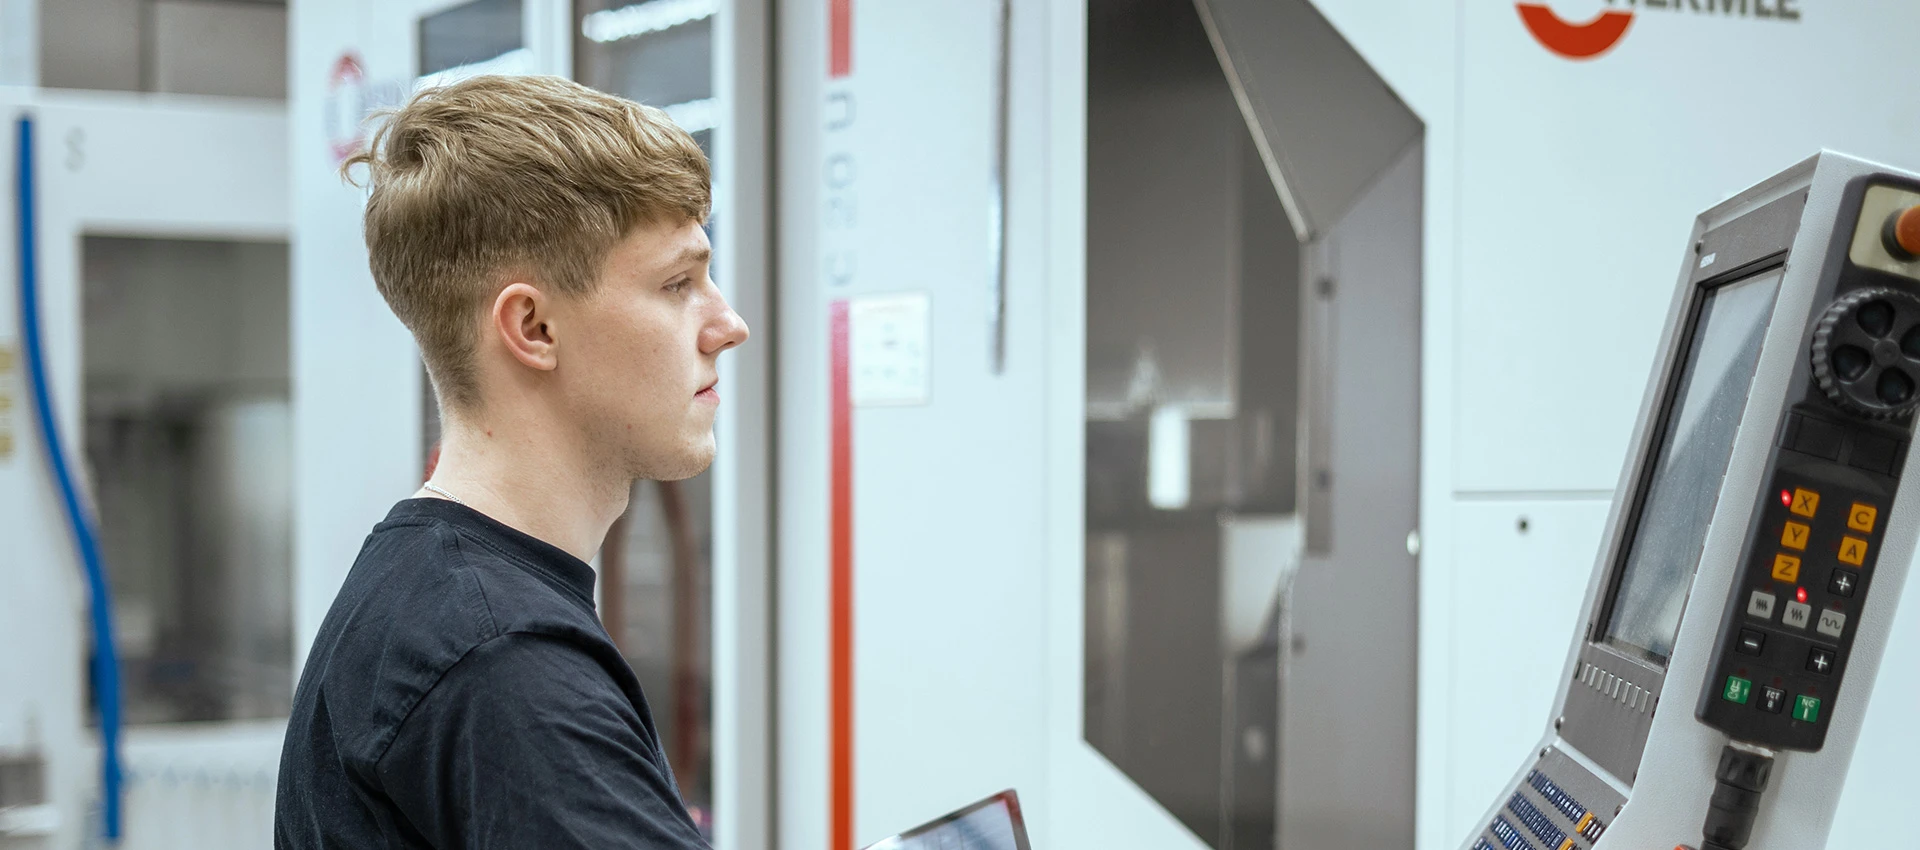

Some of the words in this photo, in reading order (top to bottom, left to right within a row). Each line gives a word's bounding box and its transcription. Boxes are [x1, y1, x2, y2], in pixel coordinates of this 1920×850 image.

[1797, 495, 1813, 513] X
[1855, 511, 1870, 525] C
[1791, 527, 1803, 542] Y
[1845, 544, 1858, 560] A
[1779, 560, 1794, 577] Z
[1765, 690, 1780, 700] FCT
[1801, 698, 1815, 708] NC
